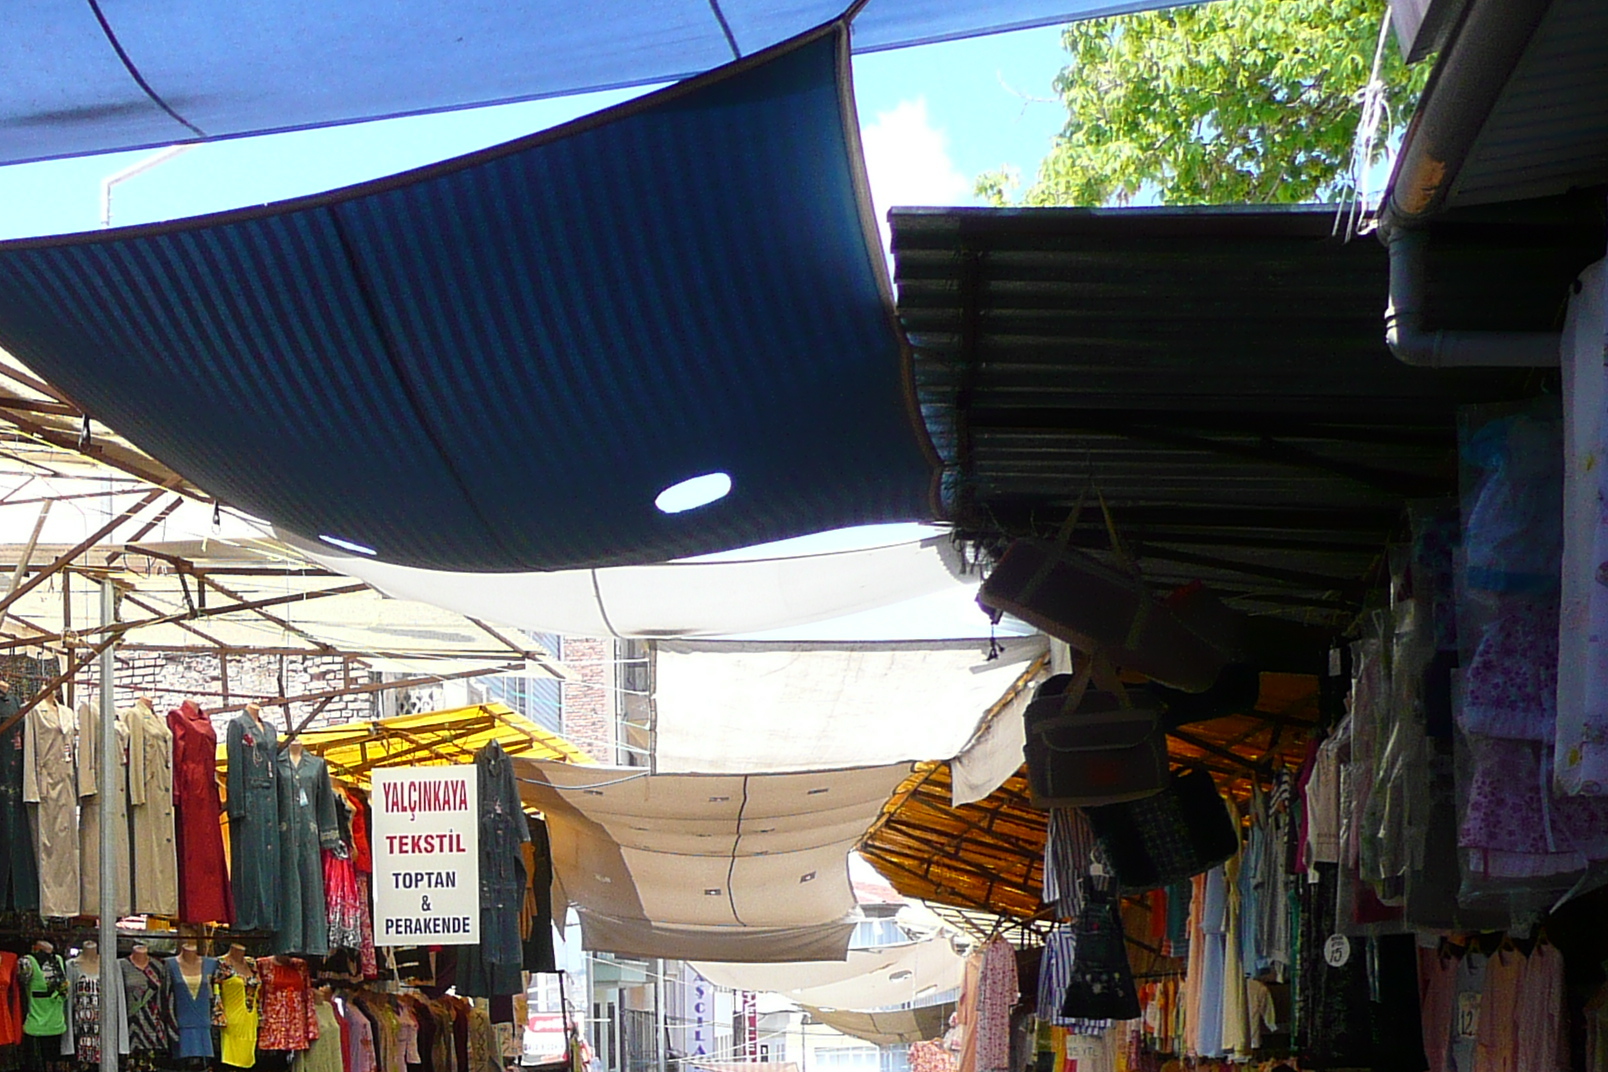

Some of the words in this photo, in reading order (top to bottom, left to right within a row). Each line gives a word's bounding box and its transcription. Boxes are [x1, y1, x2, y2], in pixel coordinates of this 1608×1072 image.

[382, 779, 469, 821] YALÇINKAYA
[385, 828, 467, 855] TEKSTİL
[392, 871, 457, 889] TOPTAN
[421, 895, 432, 912] &
[385, 916, 471, 936] PERAKENDE
